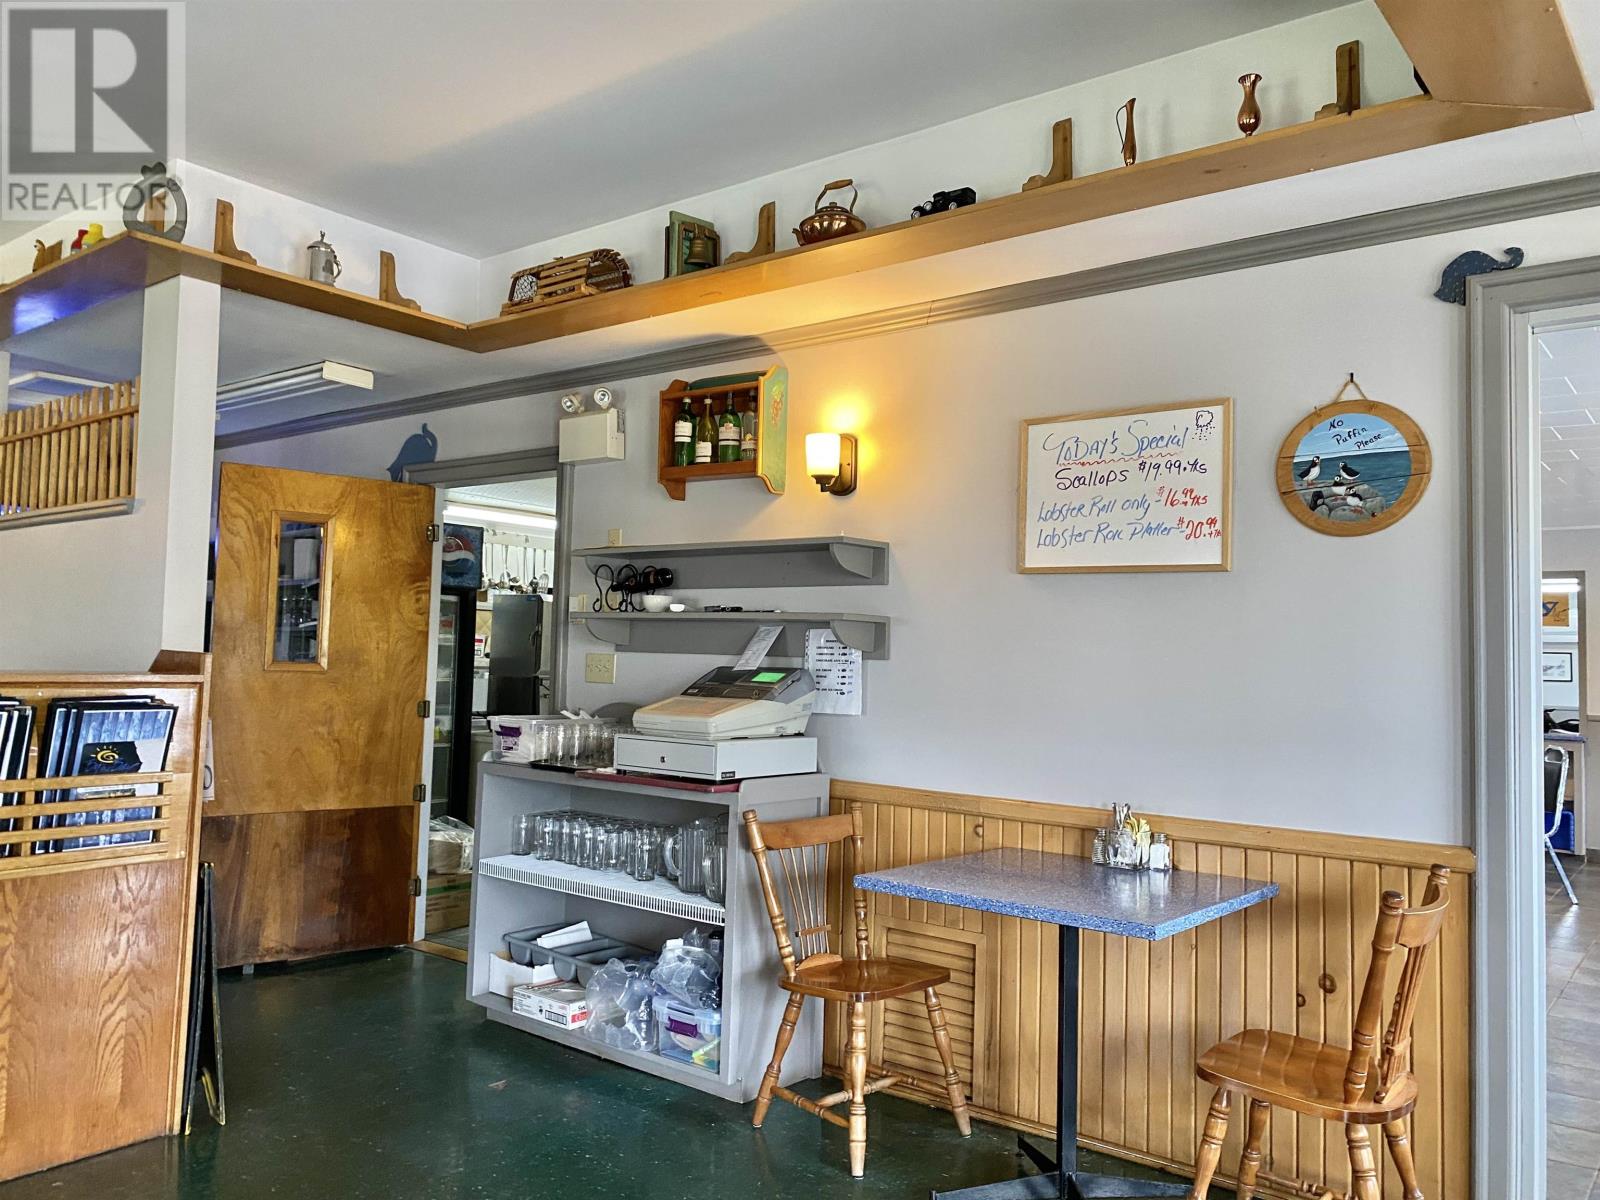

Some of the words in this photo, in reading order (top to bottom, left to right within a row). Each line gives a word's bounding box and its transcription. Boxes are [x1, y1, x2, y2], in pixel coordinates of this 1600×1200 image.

[1331, 427, 1368, 446] Puffin
[1354, 433, 1383, 450] Please
[1037, 525, 1093, 549] Lobster
